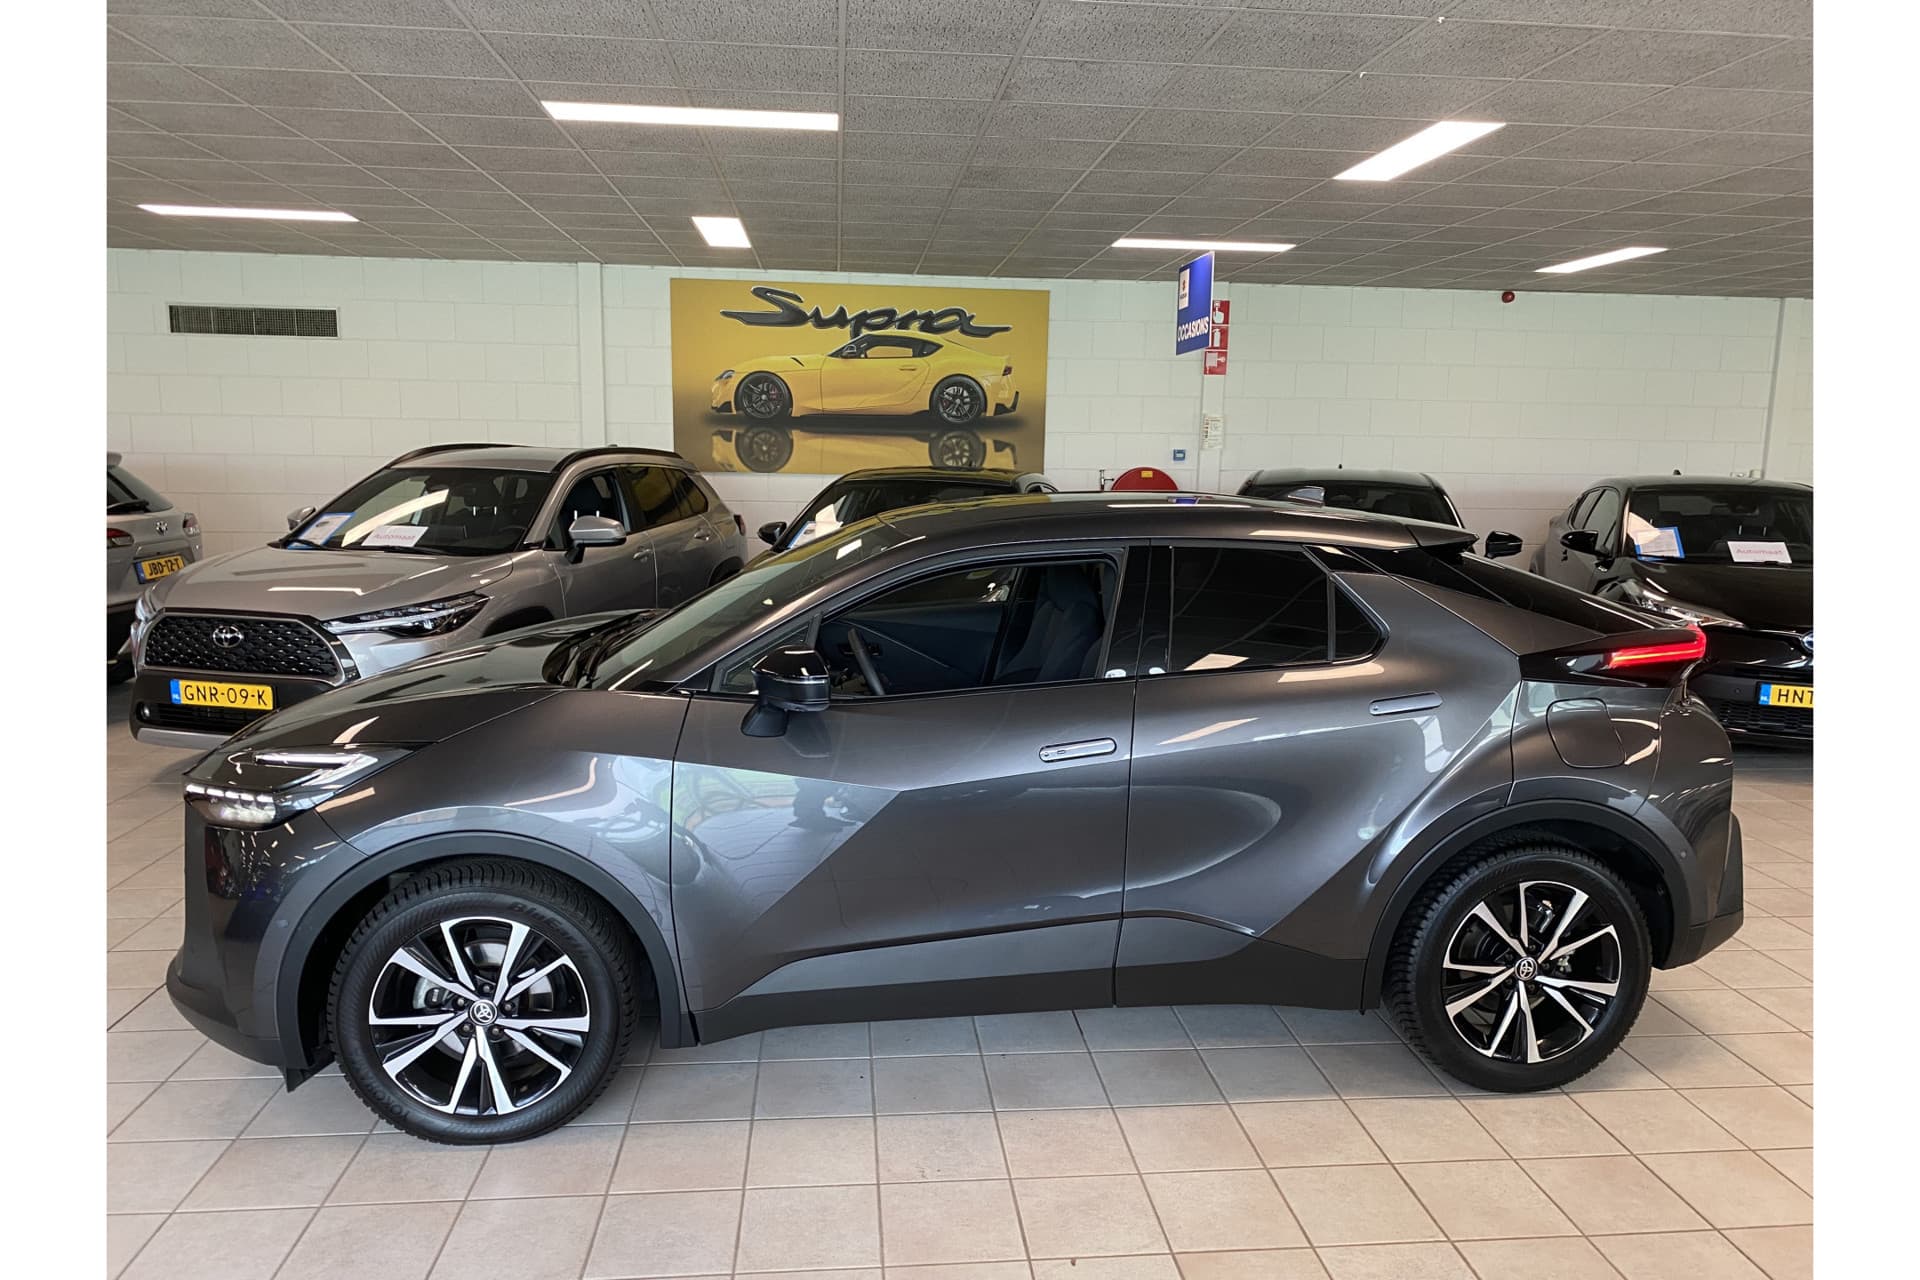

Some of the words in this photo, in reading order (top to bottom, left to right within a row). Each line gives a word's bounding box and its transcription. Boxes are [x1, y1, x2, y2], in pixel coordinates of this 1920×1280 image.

[720, 286, 1012, 338] Supra
[1177, 316, 1209, 342] OCCASIONS
[148, 557, 180, 576] JBD-12-T
[184, 684, 267, 706] GNR-09-K
